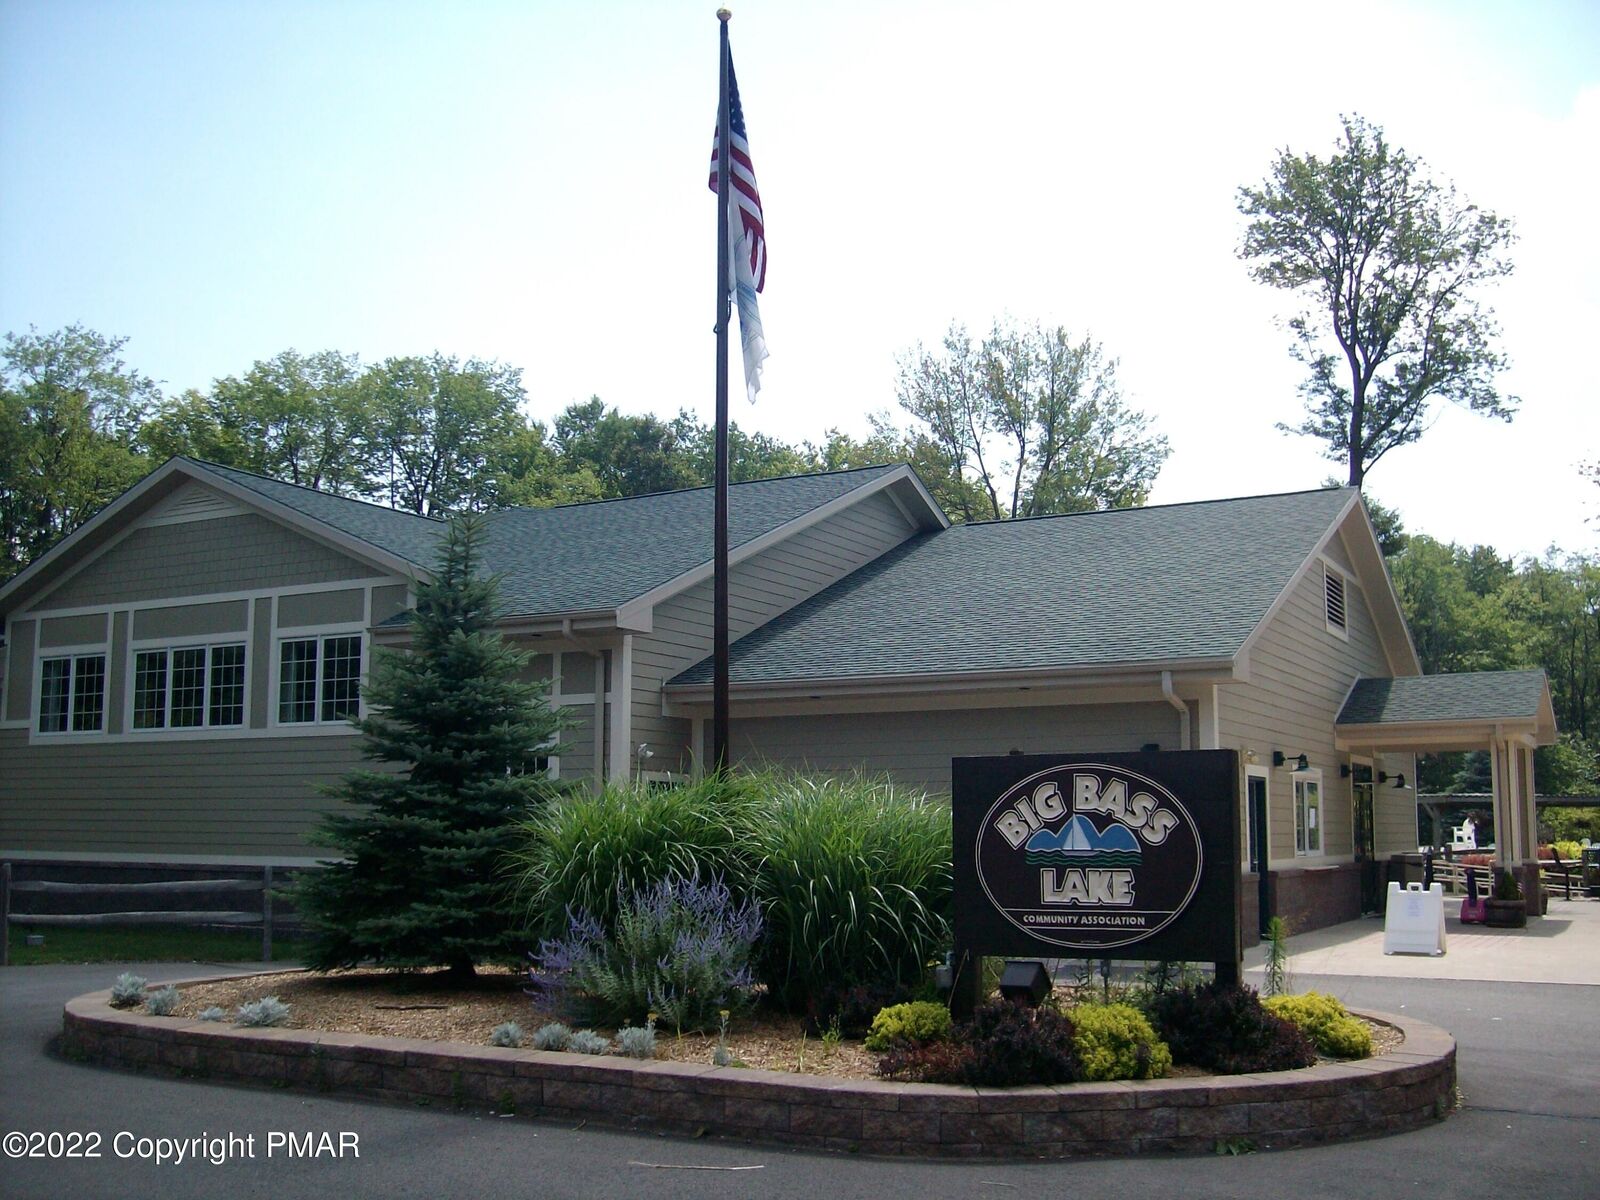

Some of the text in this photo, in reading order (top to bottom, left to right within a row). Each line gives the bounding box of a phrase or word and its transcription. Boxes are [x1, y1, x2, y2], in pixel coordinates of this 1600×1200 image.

[994, 774, 1180, 850] BIG BASS
[1040, 868, 1135, 906] LAKE
[1023, 914, 1146, 926] COMMUNITY ASSOCIATION
